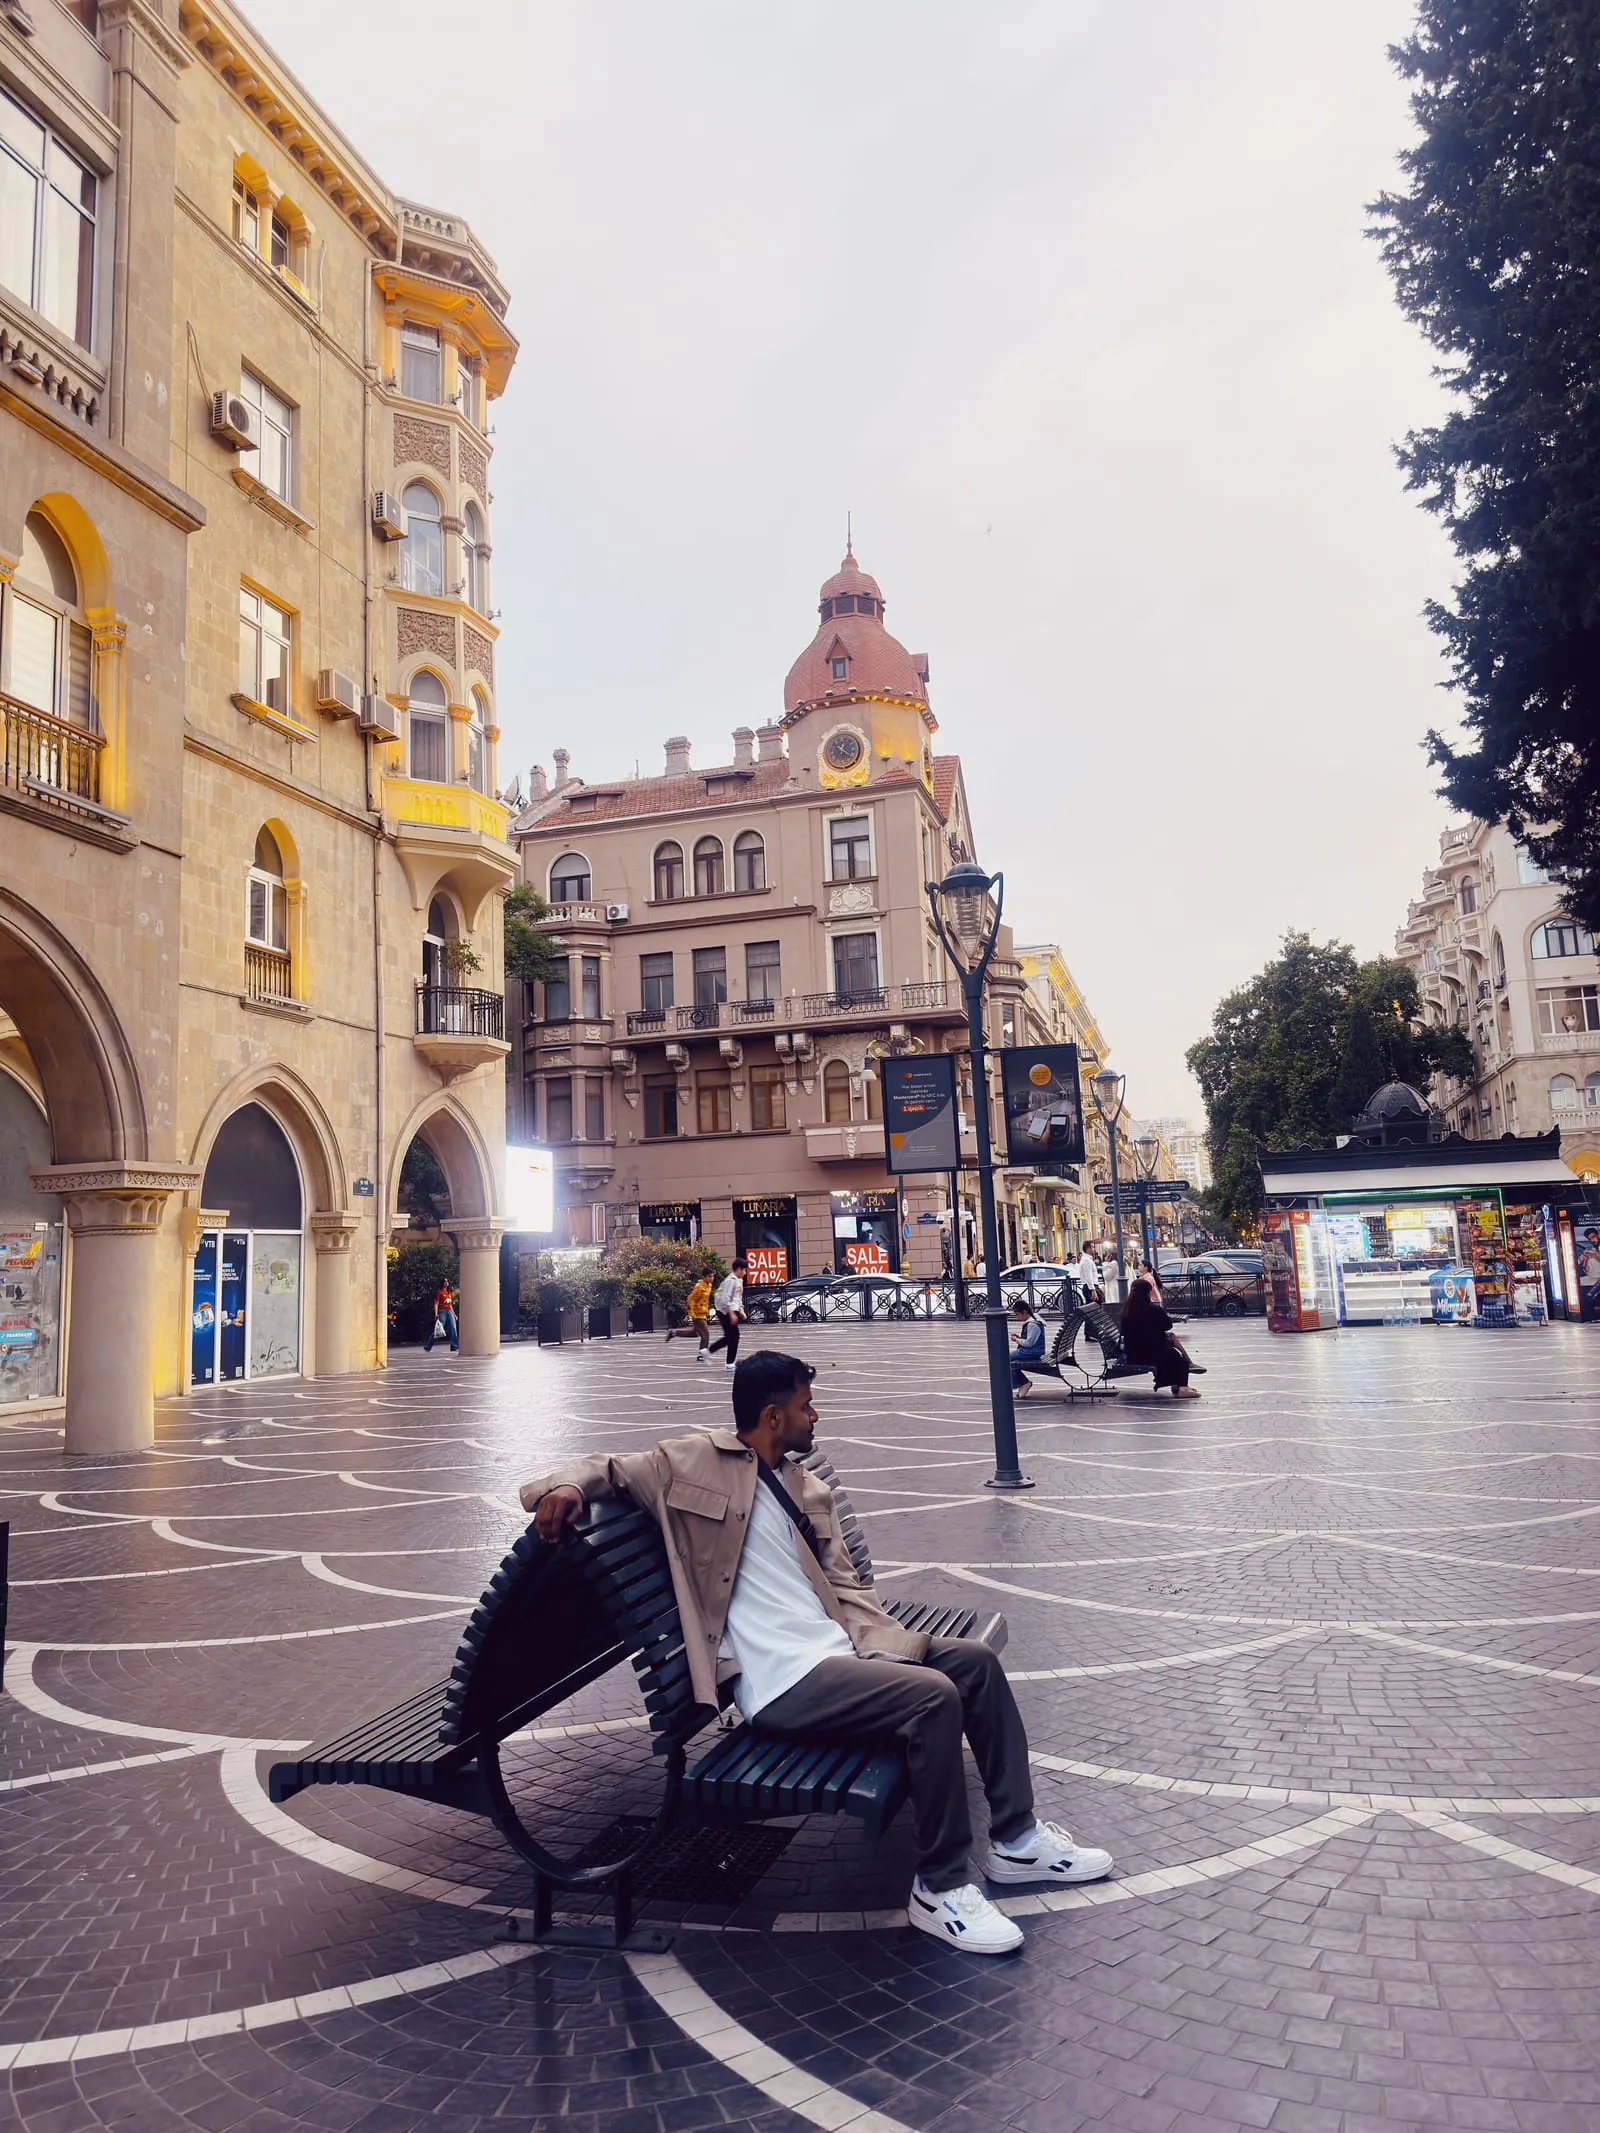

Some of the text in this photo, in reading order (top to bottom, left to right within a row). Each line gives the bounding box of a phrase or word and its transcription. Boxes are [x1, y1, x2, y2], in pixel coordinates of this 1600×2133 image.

[743, 1201, 787, 1213] LUNARIA
[205, 1240, 215, 1248] VTB
[5, 1258, 36, 1267] PEGASUS
[747, 1251, 786, 1269] SALE
[847, 1247, 888, 1266] SALE
[749, 1269, 785, 1285] 70%
